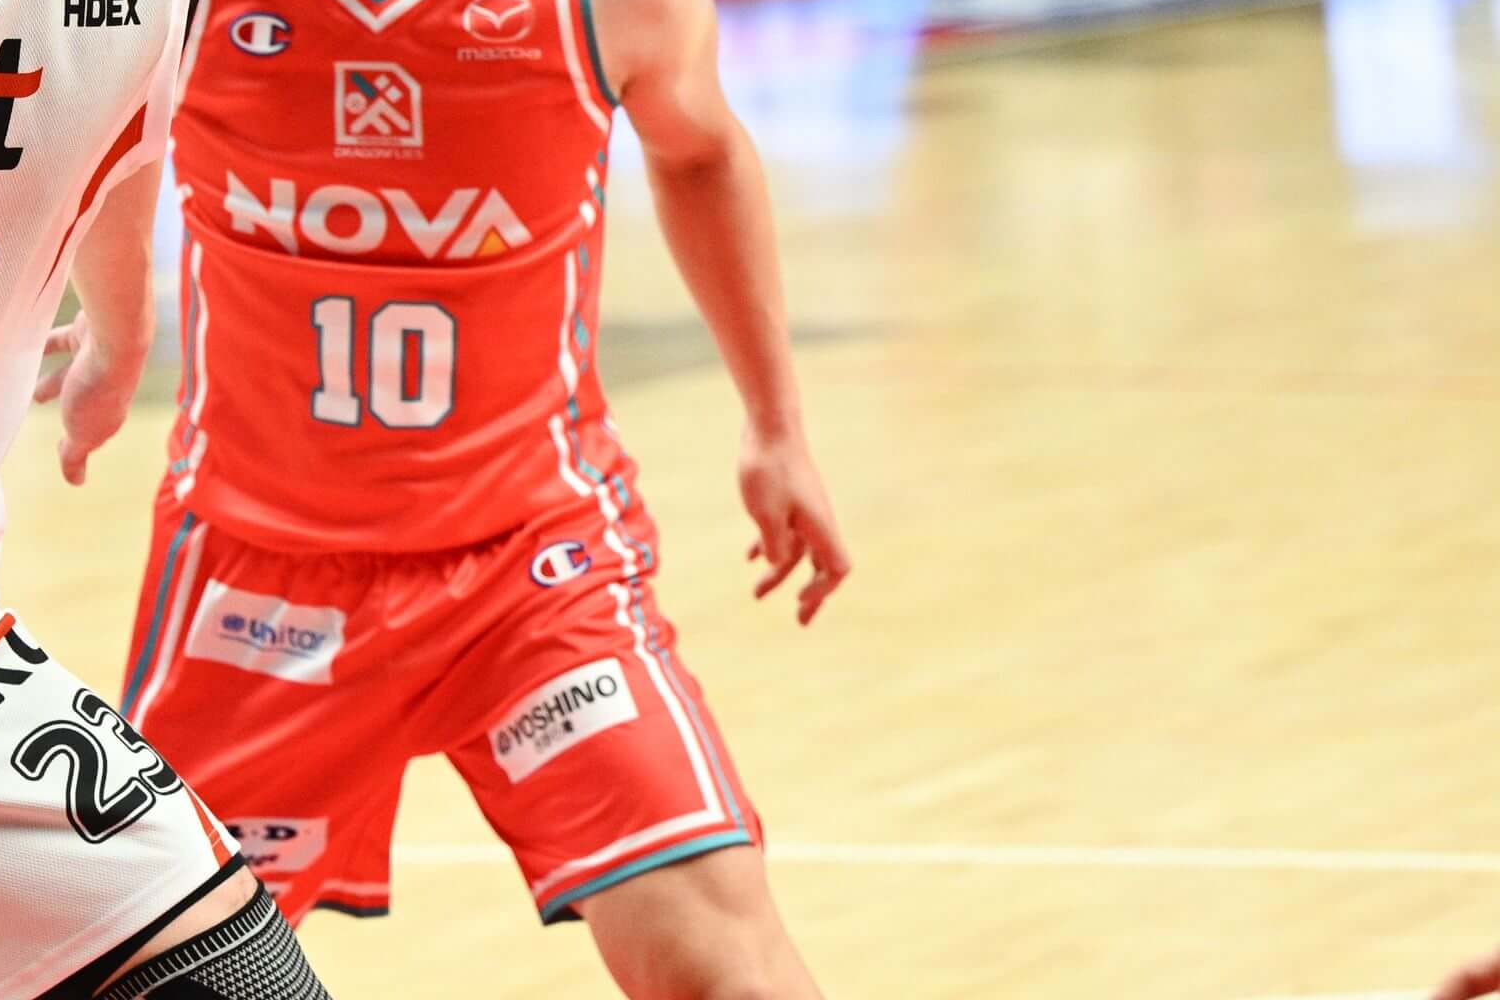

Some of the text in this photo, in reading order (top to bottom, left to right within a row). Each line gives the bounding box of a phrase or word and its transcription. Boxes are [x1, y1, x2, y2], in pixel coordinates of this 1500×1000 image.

[223, 170, 533, 260] NOVA
[310, 294, 456, 429] 10
[10, 688, 185, 844] 23
